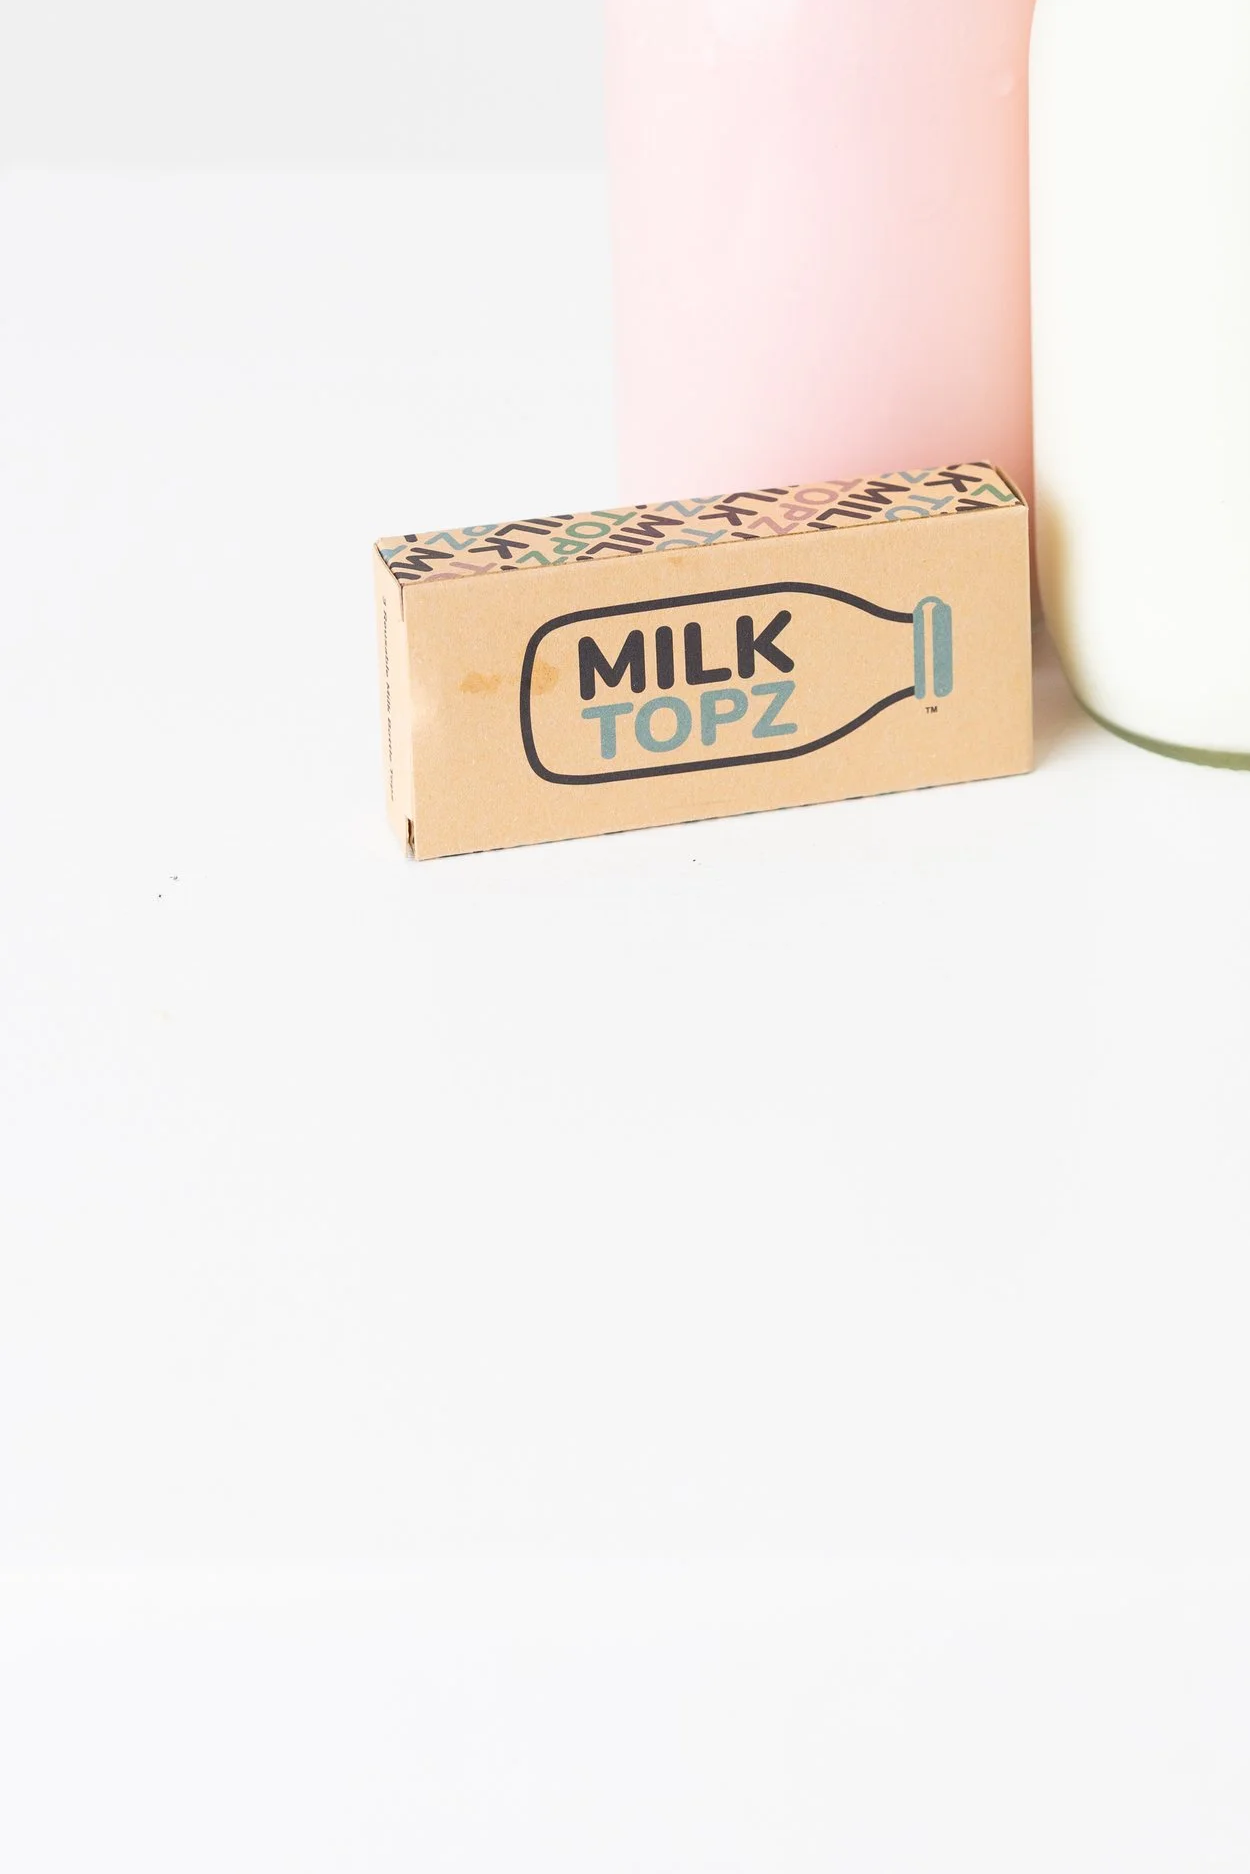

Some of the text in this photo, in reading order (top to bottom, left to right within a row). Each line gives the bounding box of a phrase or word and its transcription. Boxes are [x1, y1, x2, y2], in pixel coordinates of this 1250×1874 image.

[578, 610, 795, 700] MILK
[581, 680, 798, 760] TOPZ
[925, 706, 938, 715] TM
